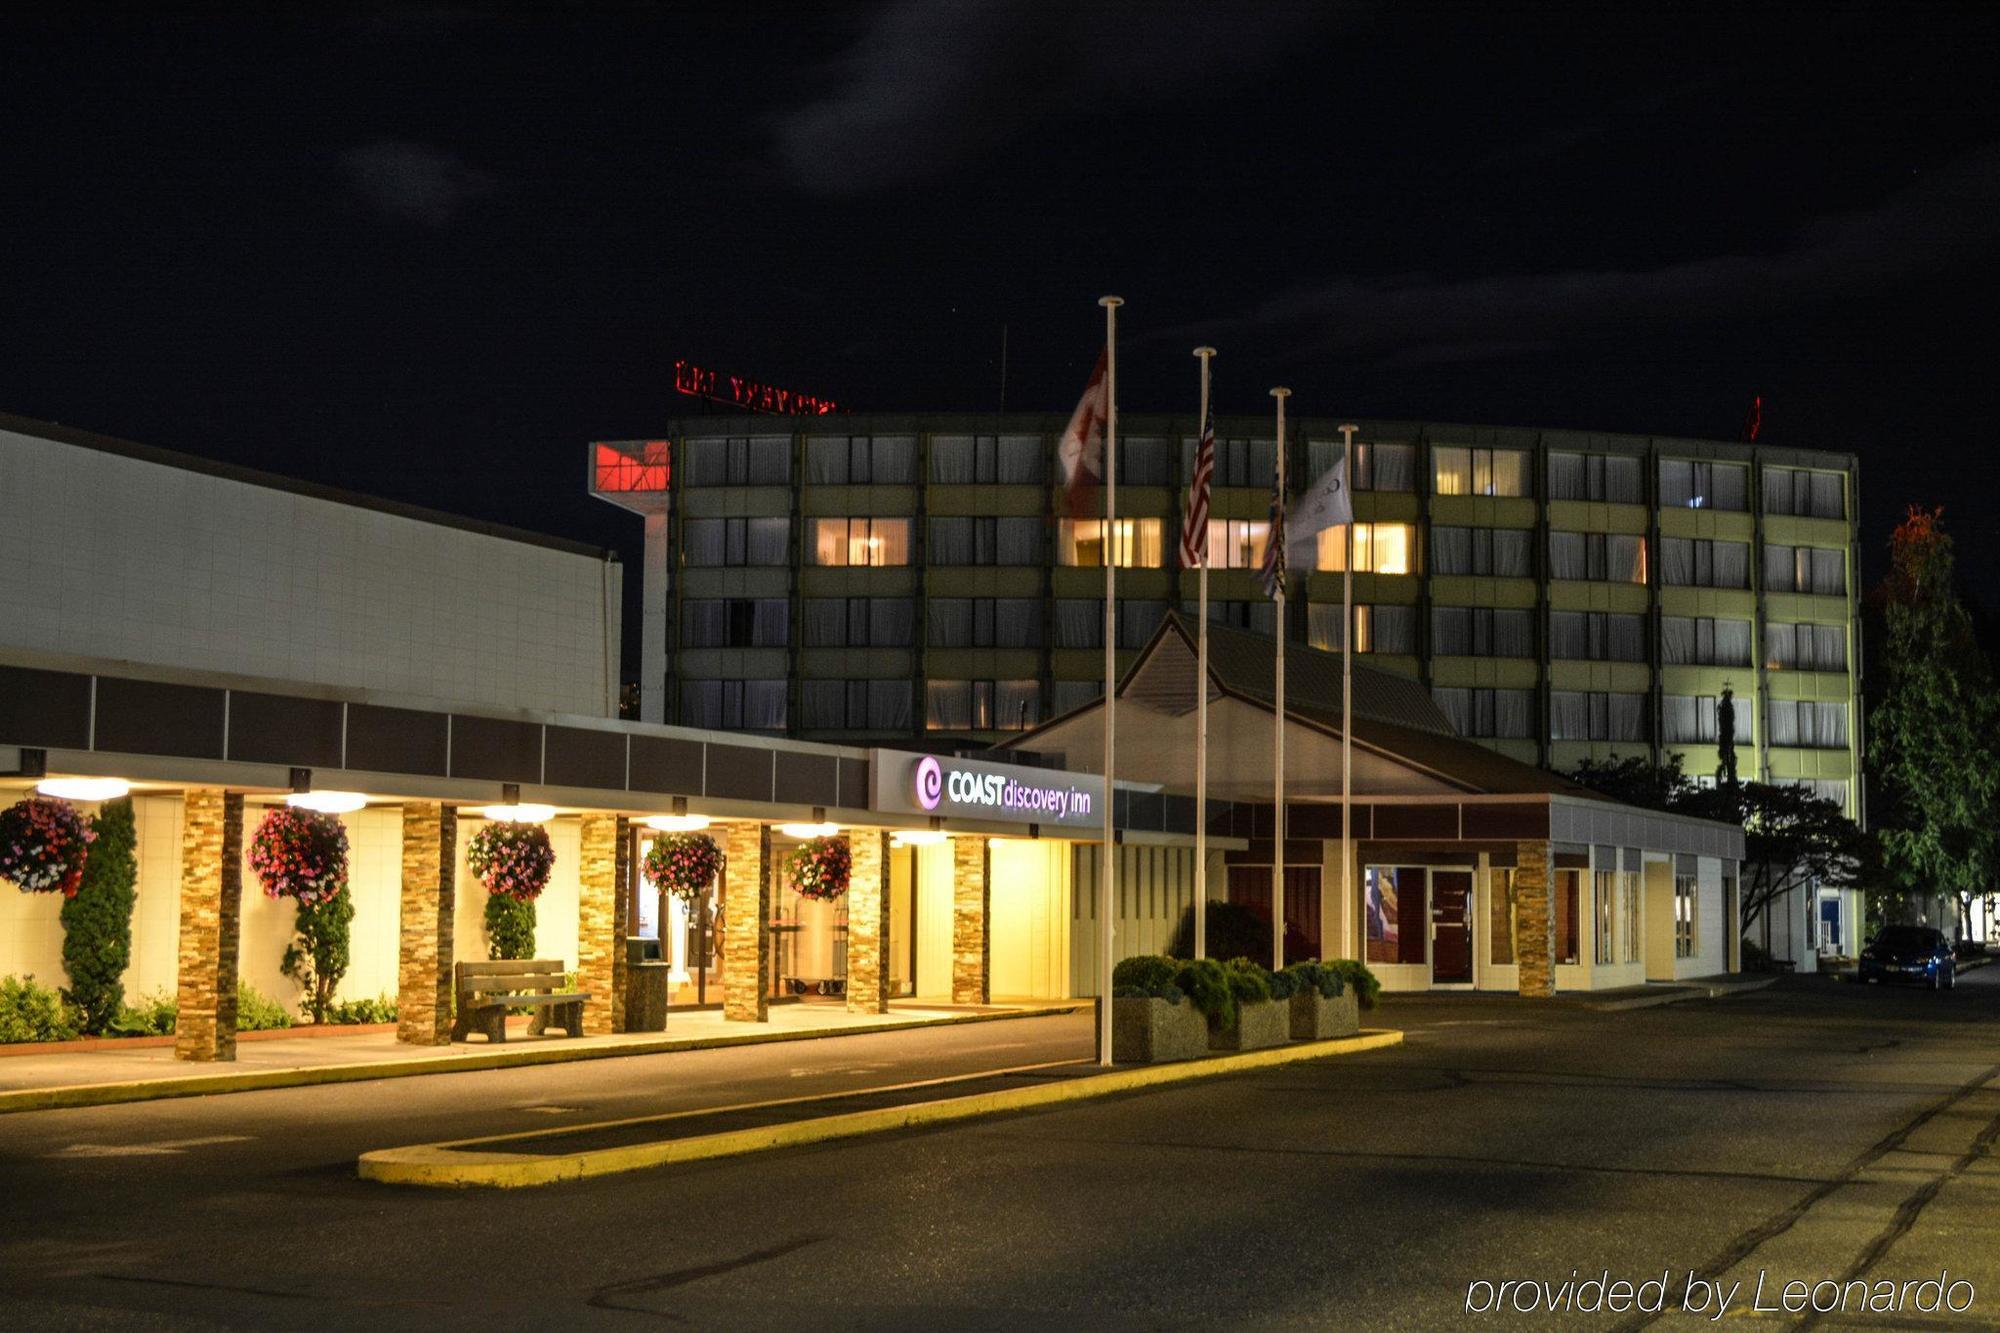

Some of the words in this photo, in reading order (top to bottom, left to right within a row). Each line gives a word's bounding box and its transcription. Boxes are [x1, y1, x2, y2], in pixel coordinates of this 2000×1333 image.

[948, 771, 1005, 806] COAST
[1004, 779, 1069, 818] discovery
[1071, 786, 1091, 814] inn
